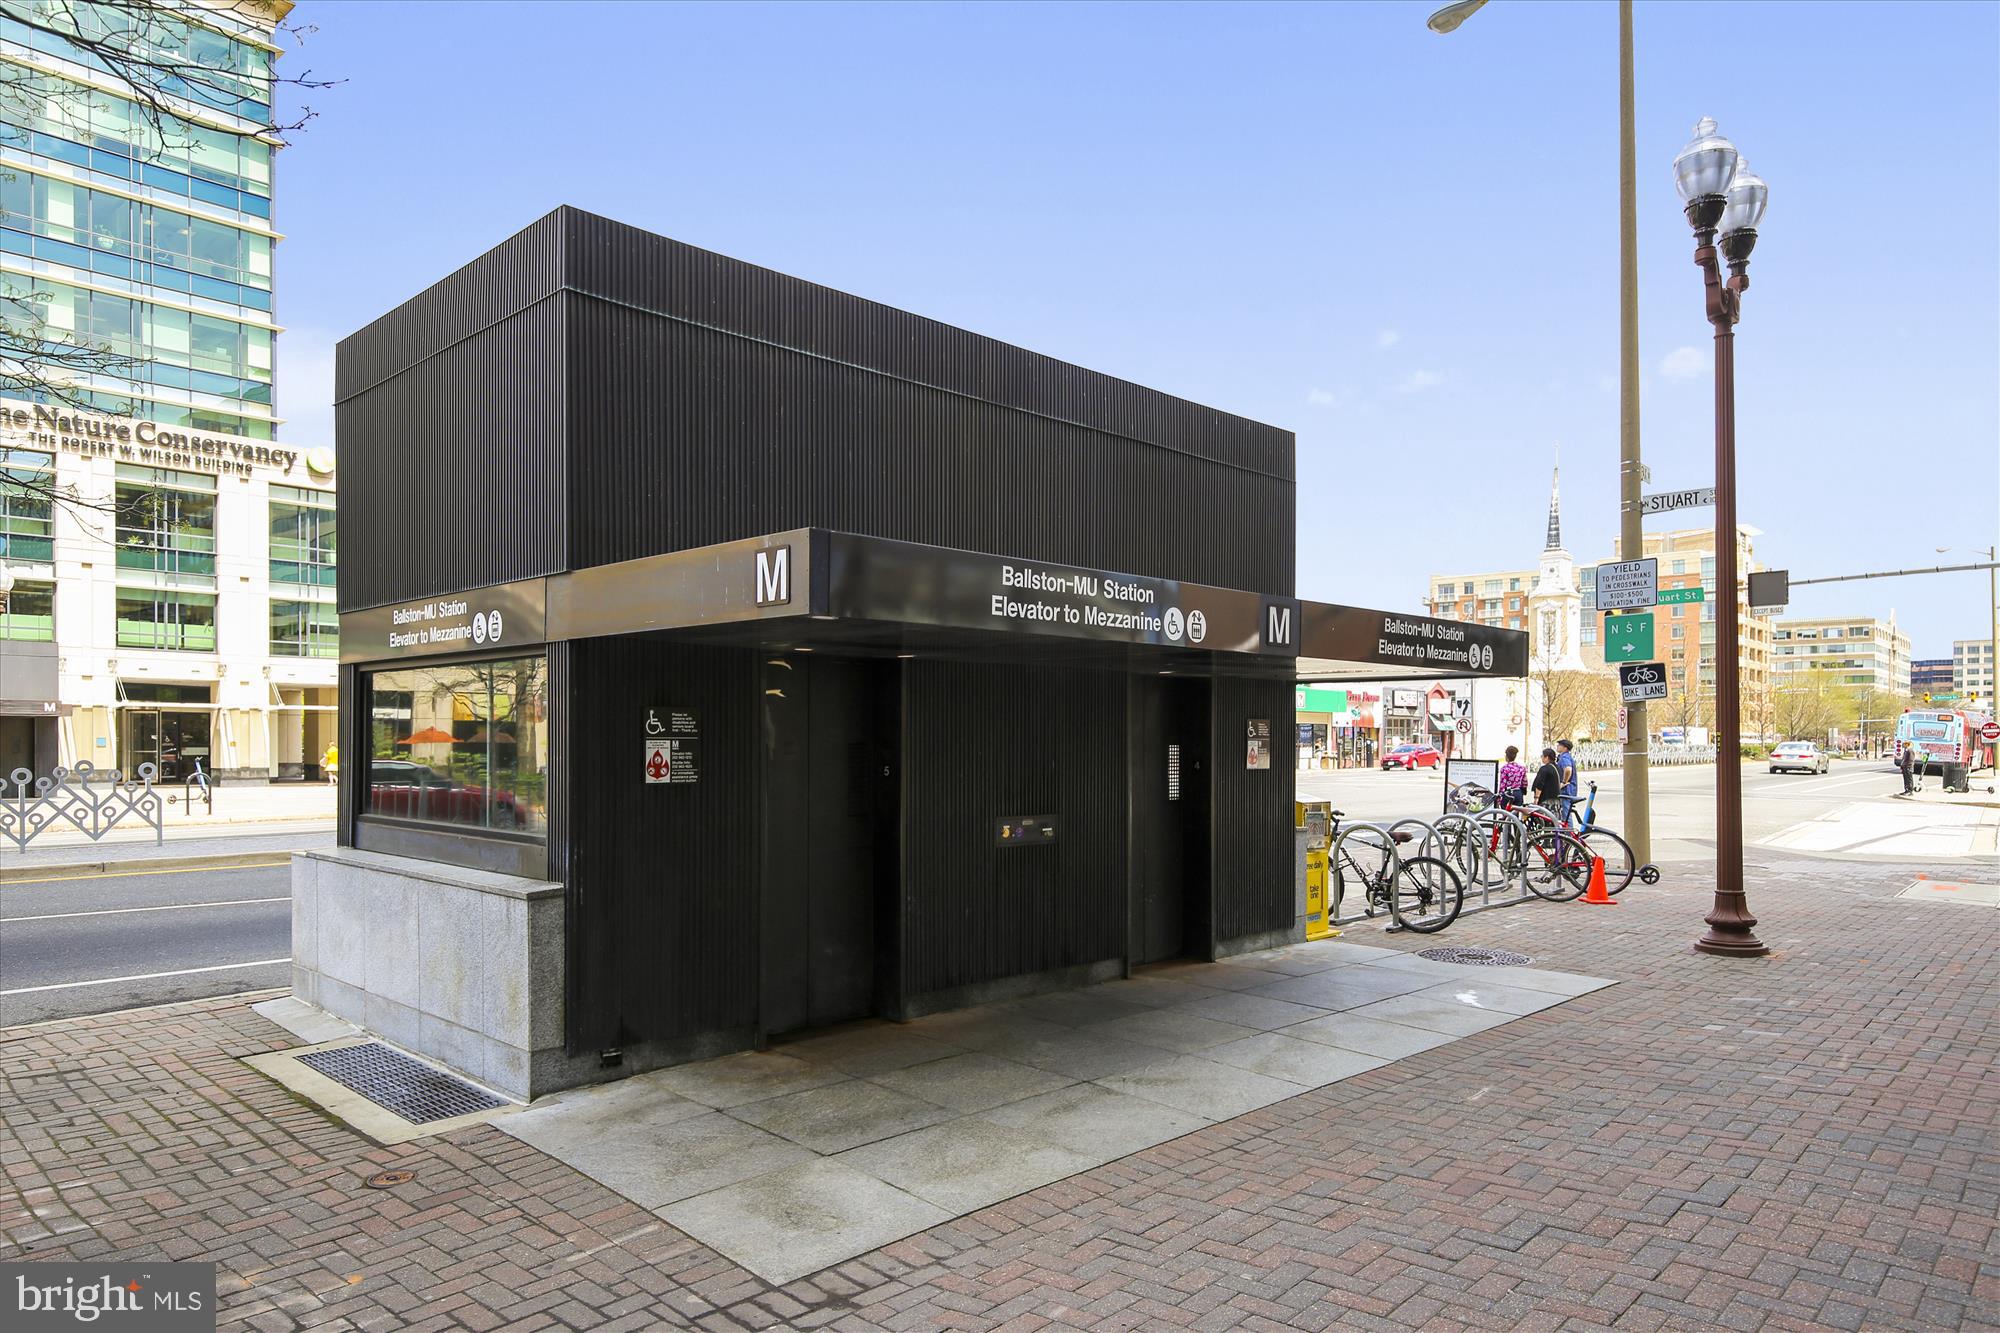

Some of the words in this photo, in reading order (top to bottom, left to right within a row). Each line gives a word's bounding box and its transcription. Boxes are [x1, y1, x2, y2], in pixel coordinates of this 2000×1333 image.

[33, 404, 130, 441] Nature
[136, 421, 298, 475] Conservancy
[28, 431, 56, 444] THE
[61, 436, 115, 451] ROBERT
[119, 444, 135, 457] W.
[140, 448, 191, 463] WILSON
[195, 455, 253, 472] BUILDING
[1651, 491, 1700, 510] STUART
[757, 548, 787, 603] M
[1611, 571, 1652, 581] PEDESTRIANS
[1613, 562, 1641, 573] YIELD
[1002, 565, 1098, 596] Ballston-MU
[1104, 579, 1154, 604] Station
[1605, 582, 1612, 590] IN
[1613, 580, 1648, 589] CROSSWALK
[1610, 590, 1644, 600] $100-$500
[1603, 599, 1634, 607] VIOLATION
[1637, 597, 1650, 605] FINE
[1684, 591, 1700, 600] St.
[393, 603, 437, 625] Ballston-MU
[439, 599, 467, 618] Station
[991, 595, 1060, 623] Elevator
[1063, 604, 1080, 624] to
[1085, 606, 1161, 632] Mezzanine
[389, 631, 419, 648] Elevator
[420, 629, 428, 644] to
[430, 623, 472, 643] Mezzanine
[1268, 605, 1291, 645] M
[1384, 617, 1435, 639] Ballston-MU
[1437, 626, 1465, 642] Station
[1611, 624, 1619, 634] N
[1626, 623, 1633, 633] S
[1640, 622, 1647, 633] F
[1378, 639, 1414, 658] Elevator
[1416, 645, 1425, 658] to
[1426, 644, 1468, 663] Mezzanine
[1624, 687, 1640, 697] BIKE
[1644, 684, 1665, 696] LANE
[44, 702, 56, 712] M
